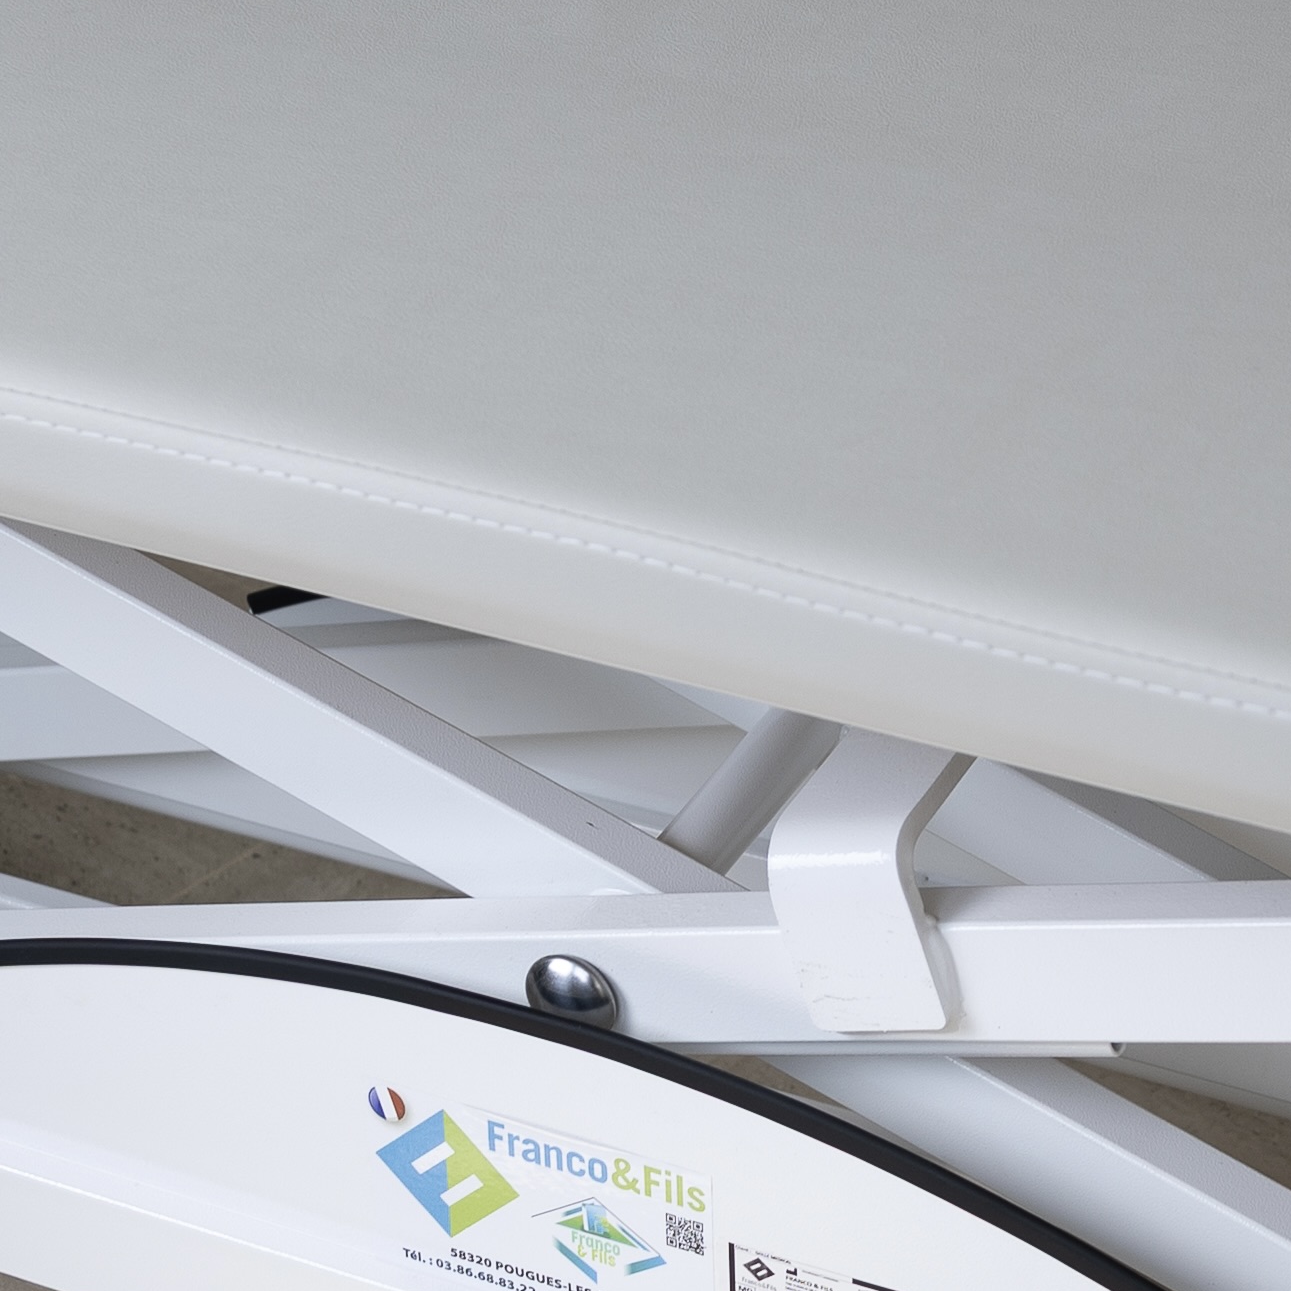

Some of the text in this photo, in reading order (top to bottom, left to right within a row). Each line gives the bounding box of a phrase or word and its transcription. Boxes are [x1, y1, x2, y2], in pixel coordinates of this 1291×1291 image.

[487, 1119, 707, 1214] Franco&Fils
[570, 1229, 621, 1257] Franco
[450, 1247, 492, 1269] 58320
[591, 1249, 617, 1268] Fils
